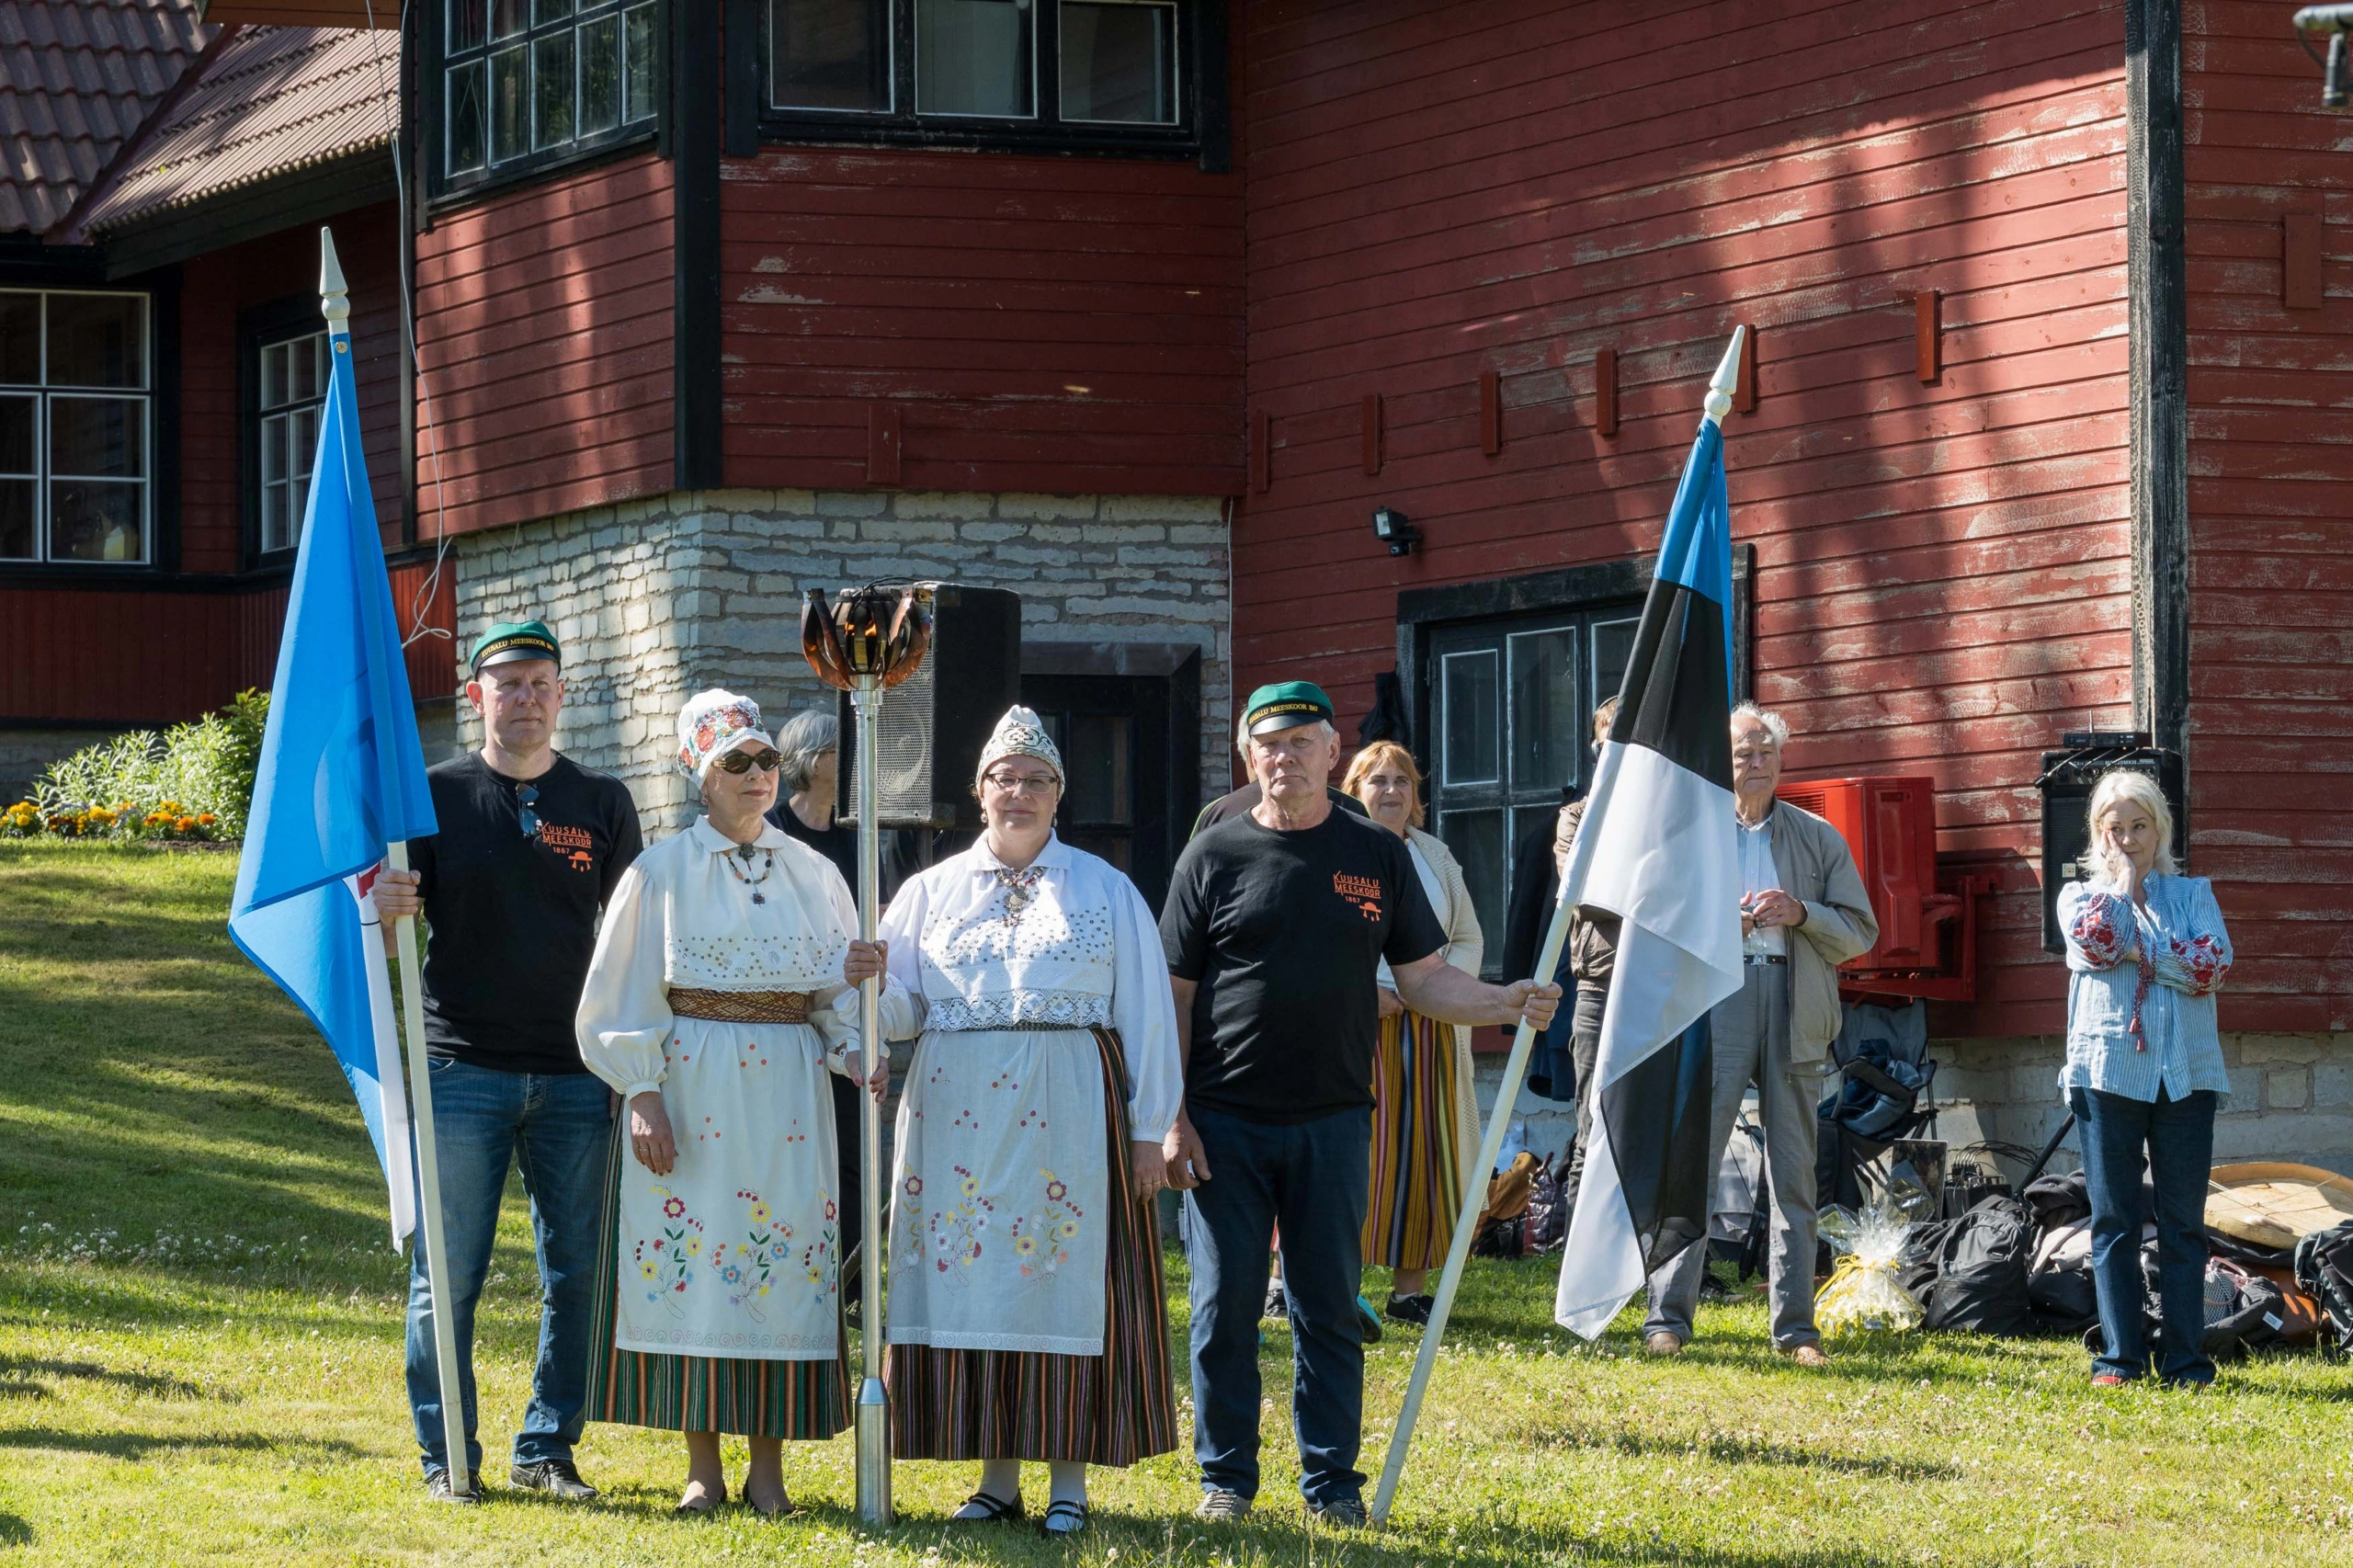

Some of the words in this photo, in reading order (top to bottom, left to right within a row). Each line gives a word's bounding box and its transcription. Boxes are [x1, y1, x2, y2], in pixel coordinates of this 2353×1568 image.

[481, 641, 508, 658] KUUSALU
[1270, 703, 1308, 714] MEESKOOR
[541, 821, 590, 837] KUUSALU
[542, 834, 592, 846] MEESKOOR
[553, 846, 570, 855] 1867
[1334, 870, 1379, 888] KUUSALU
[1335, 882, 1381, 897] MEESKOOR
[1345, 895, 1360, 903] 1867
